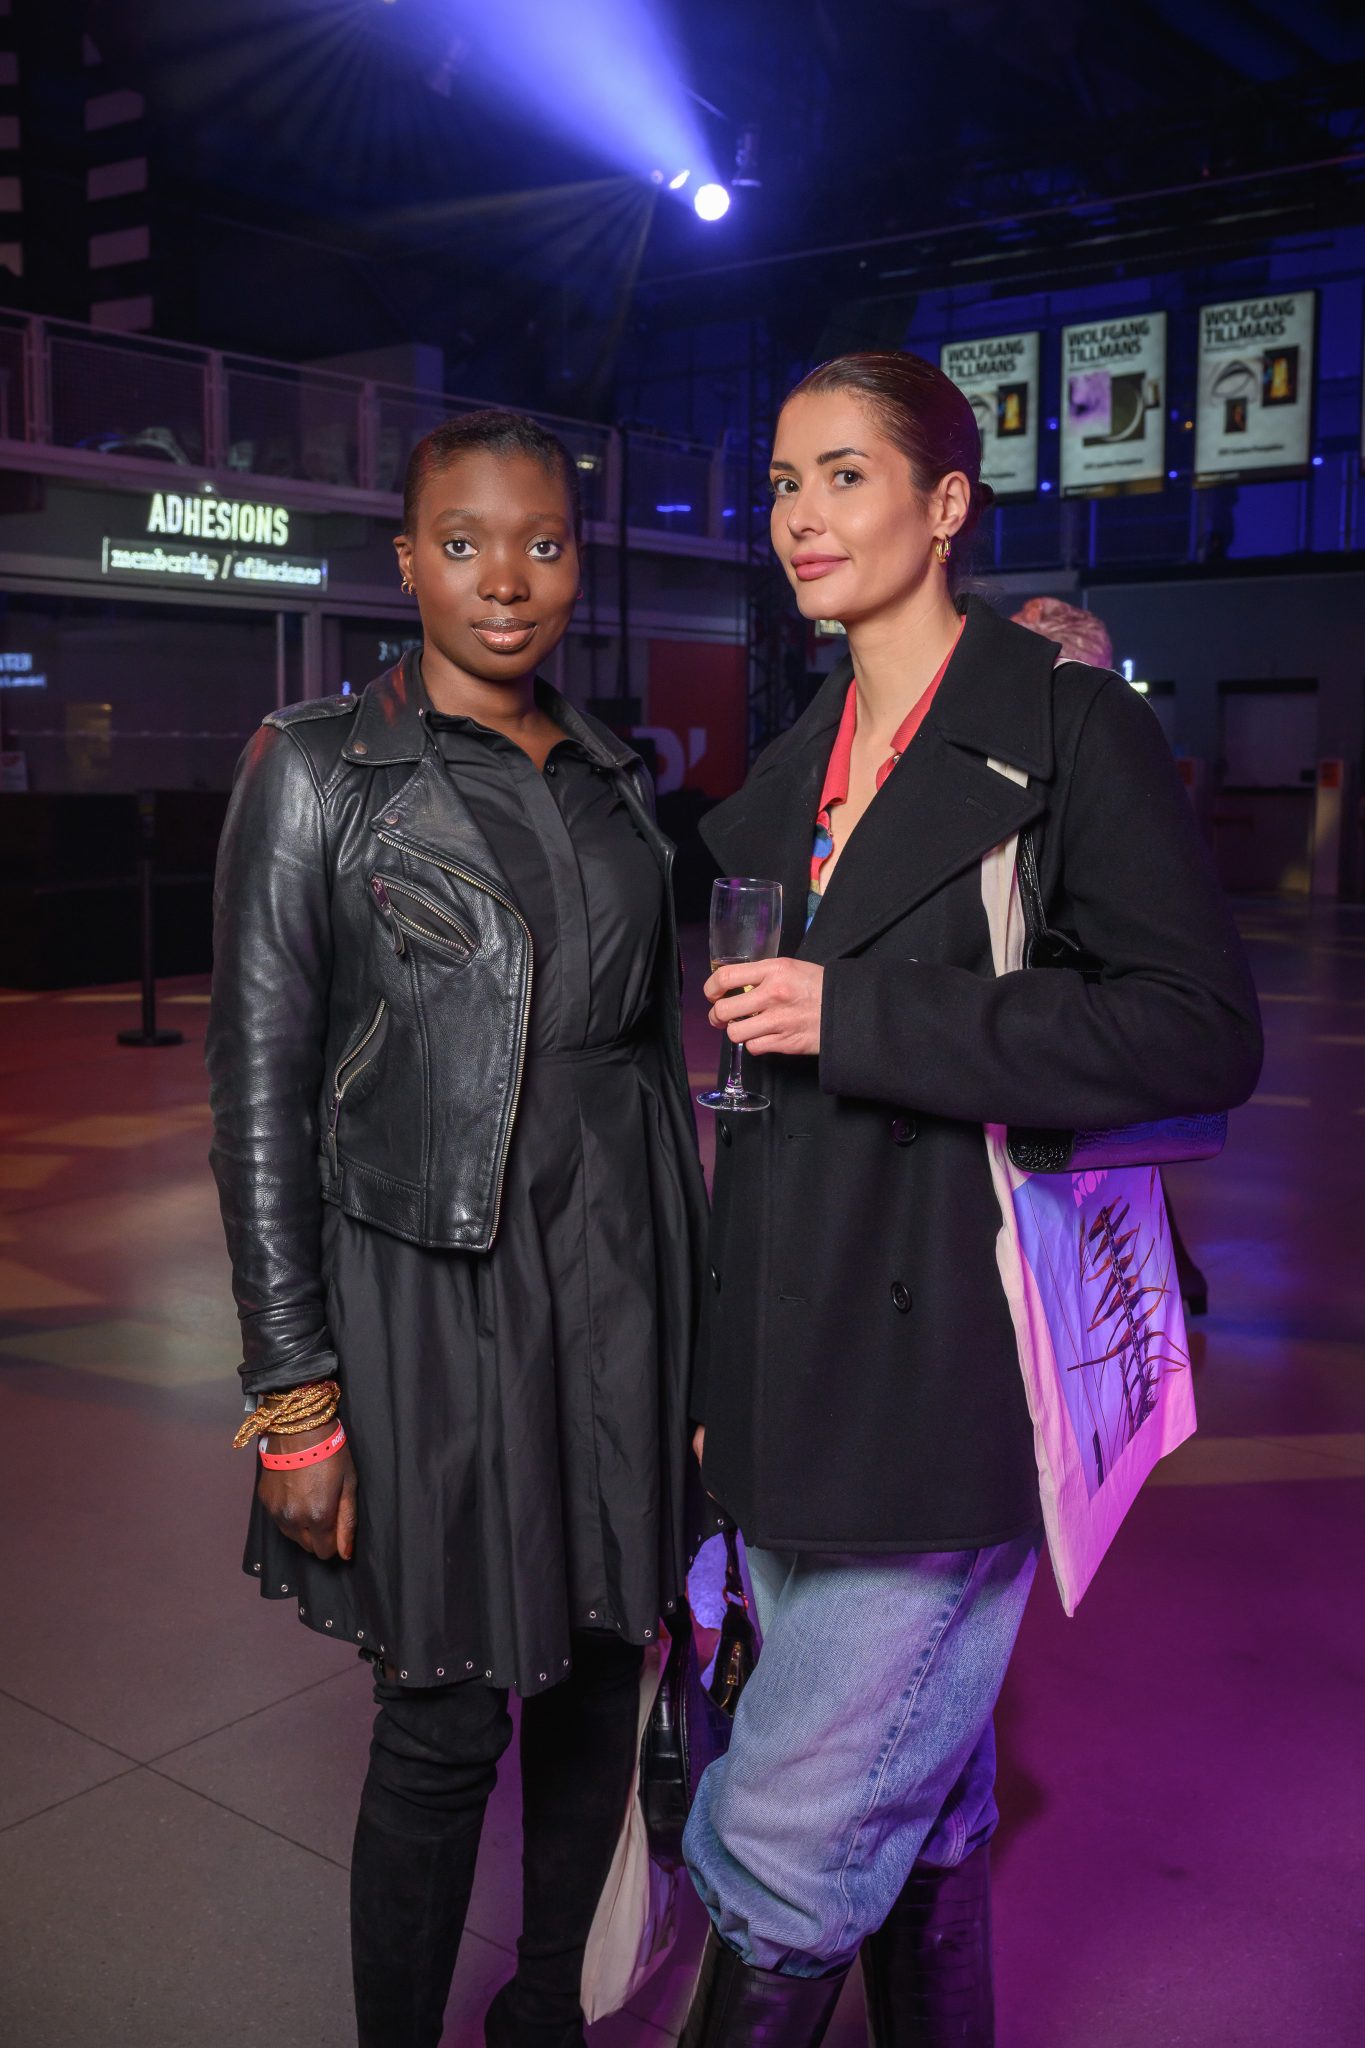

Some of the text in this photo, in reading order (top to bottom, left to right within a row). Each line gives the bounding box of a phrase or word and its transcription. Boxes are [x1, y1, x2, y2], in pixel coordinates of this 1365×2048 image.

[1204, 298, 1295, 326] WOLFGANG
[1067, 319, 1150, 346] WOLFGANG
[1205, 317, 1285, 343] TILLMANS
[947, 338, 1024, 362] WOLFGANG
[1068, 336, 1142, 363] TILLMANS
[948, 355, 1017, 379] TILLMANS
